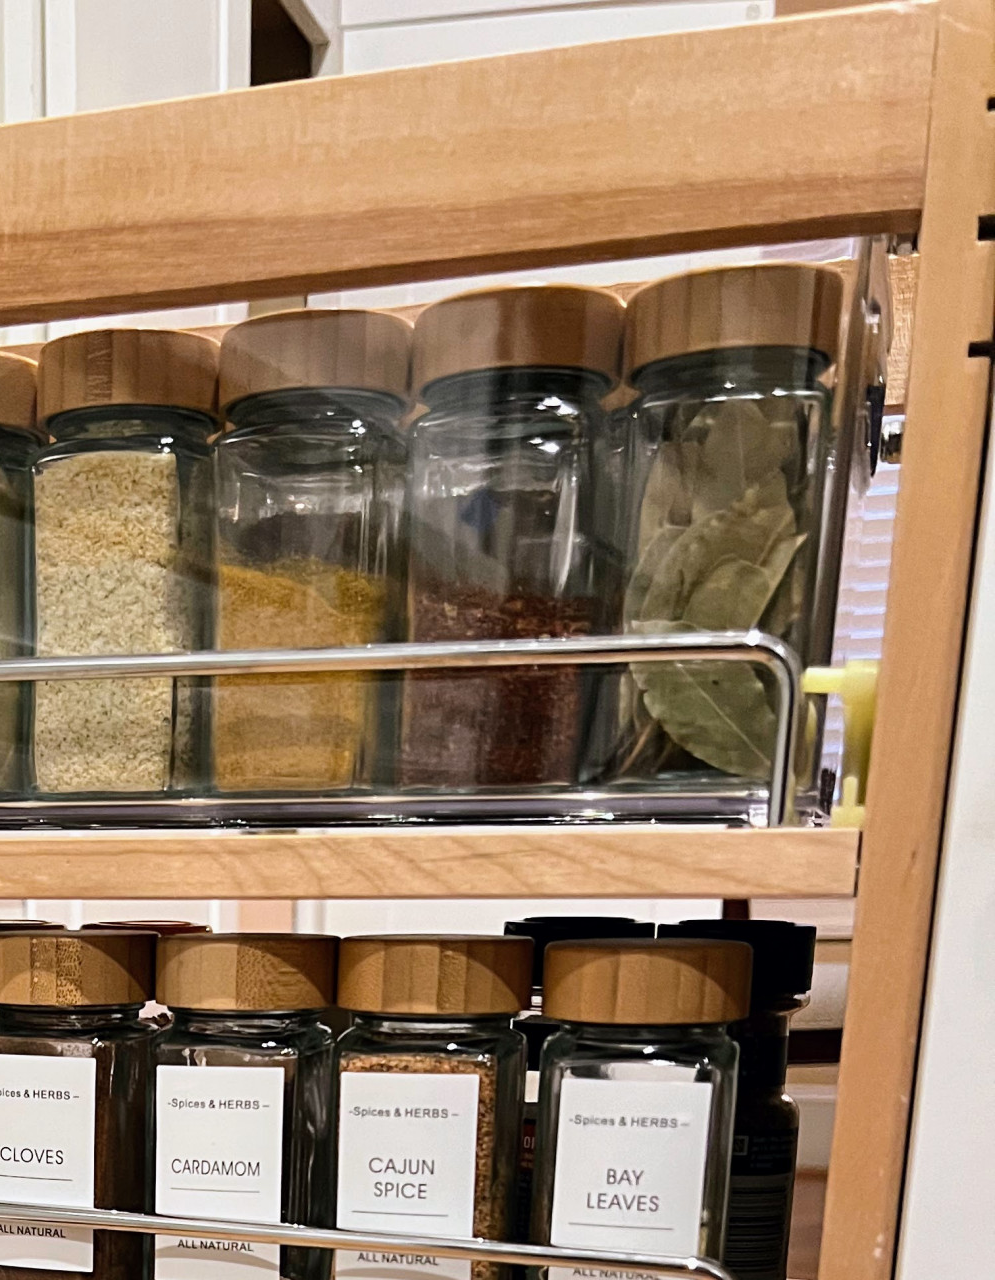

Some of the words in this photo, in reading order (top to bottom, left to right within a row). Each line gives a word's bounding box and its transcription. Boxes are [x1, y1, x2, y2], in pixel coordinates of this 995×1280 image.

[32, 1089, 71, 1100] HERBS
[219, 1099, 260, 1110] HERBS
[404, 1108, 448, 1119] HERBS
[630, 1117, 678, 1129] HERBS
[0, 1146, 64, 1165] CLOVES
[171, 1158, 261, 1177] CARDAMOM
[368, 1157, 435, 1176] CAJUN
[606, 1168, 644, 1186] BAY
[373, 1182, 428, 1200] SPICE
[586, 1193, 660, 1213] LEAVES
[16, 1225, 66, 1239] NATURAL
[177, 1239, 198, 1250] ALL
[199, 1240, 254, 1252] NATURAL
[357, 1252, 379, 1264] ALL
[381, 1253, 439, 1266] NATURAL
